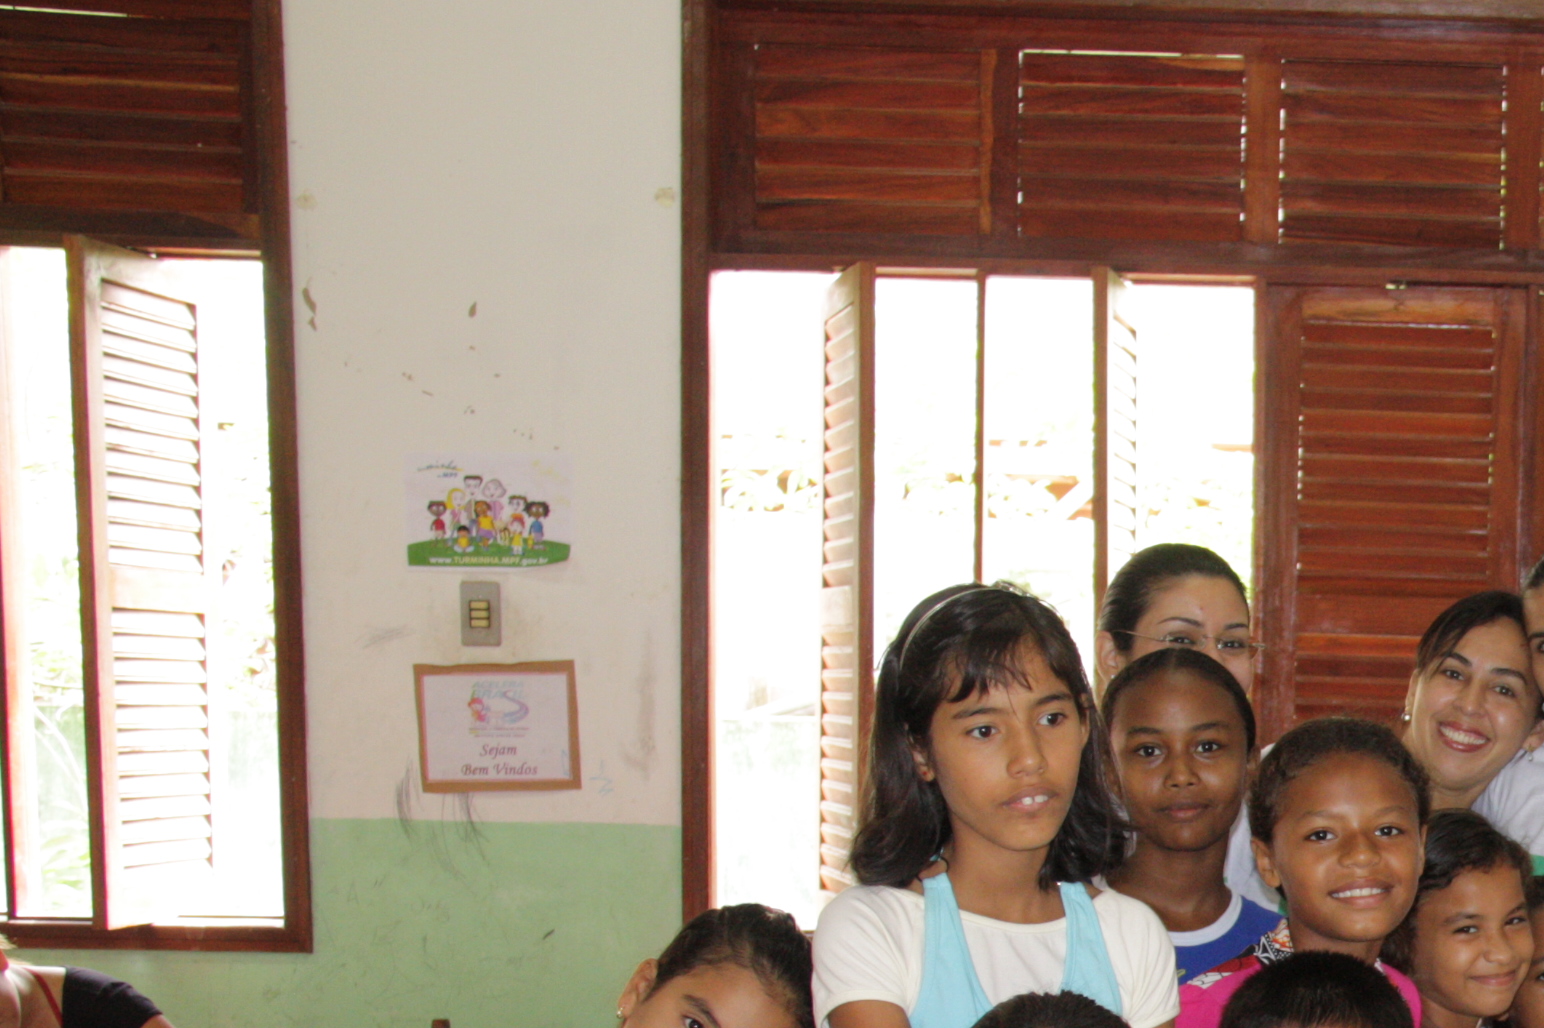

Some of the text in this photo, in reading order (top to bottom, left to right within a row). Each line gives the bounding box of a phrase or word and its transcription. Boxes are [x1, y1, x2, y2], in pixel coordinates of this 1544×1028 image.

[479, 743, 518, 760] Sejam
[461, 761, 538, 776] Bem Vindos
